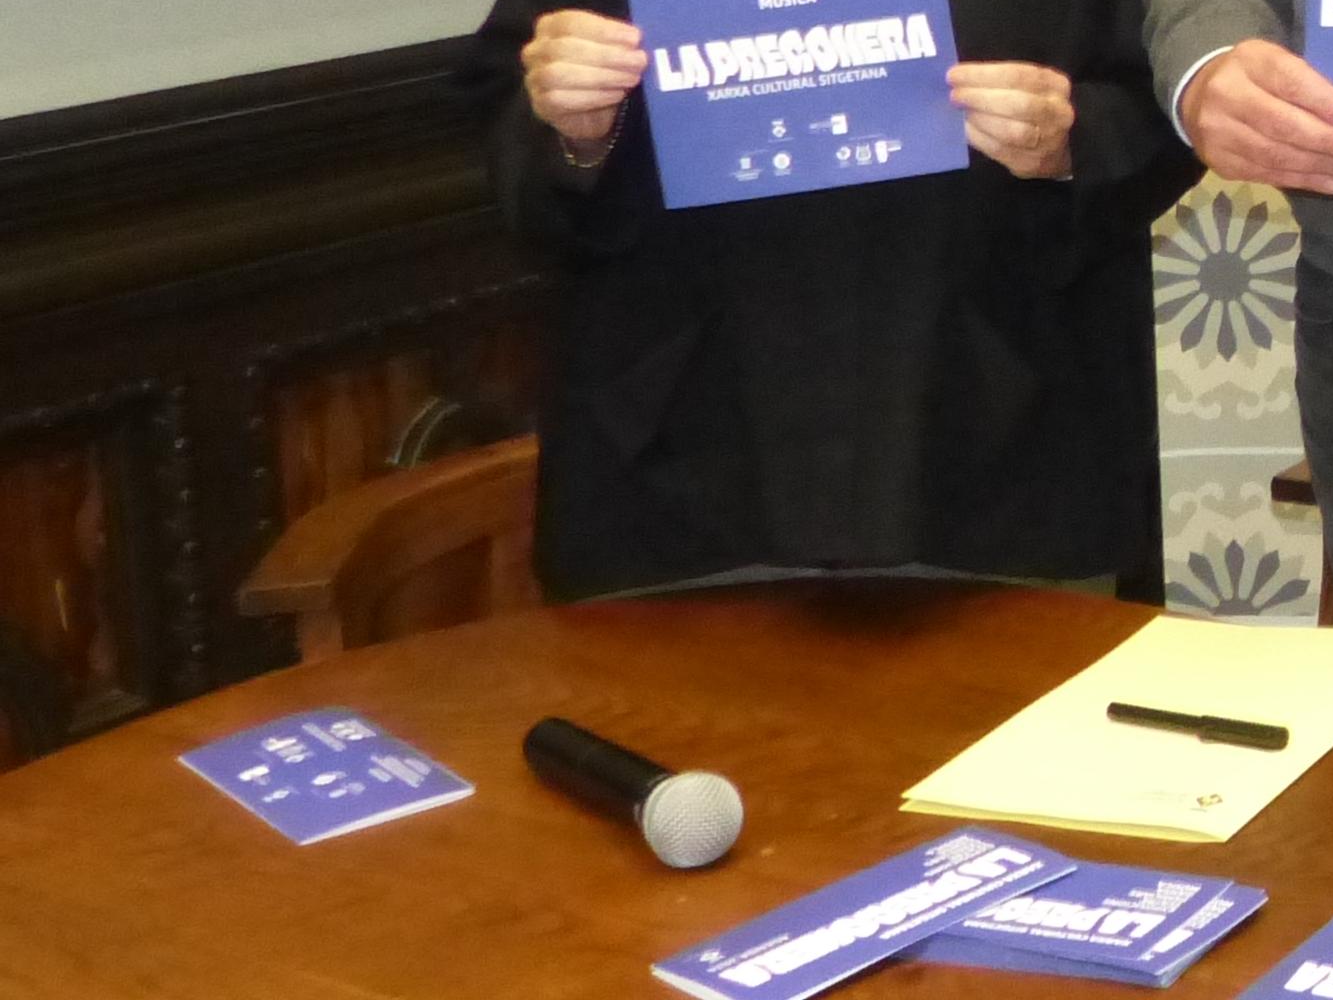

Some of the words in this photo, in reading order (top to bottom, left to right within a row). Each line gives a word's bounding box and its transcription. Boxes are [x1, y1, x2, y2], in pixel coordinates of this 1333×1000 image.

[655, 45, 710, 92] LA
[707, 85, 751, 101] XARXA
[753, 76, 816, 96] CULTURAL
[819, 67, 887, 86] SITGETANA
